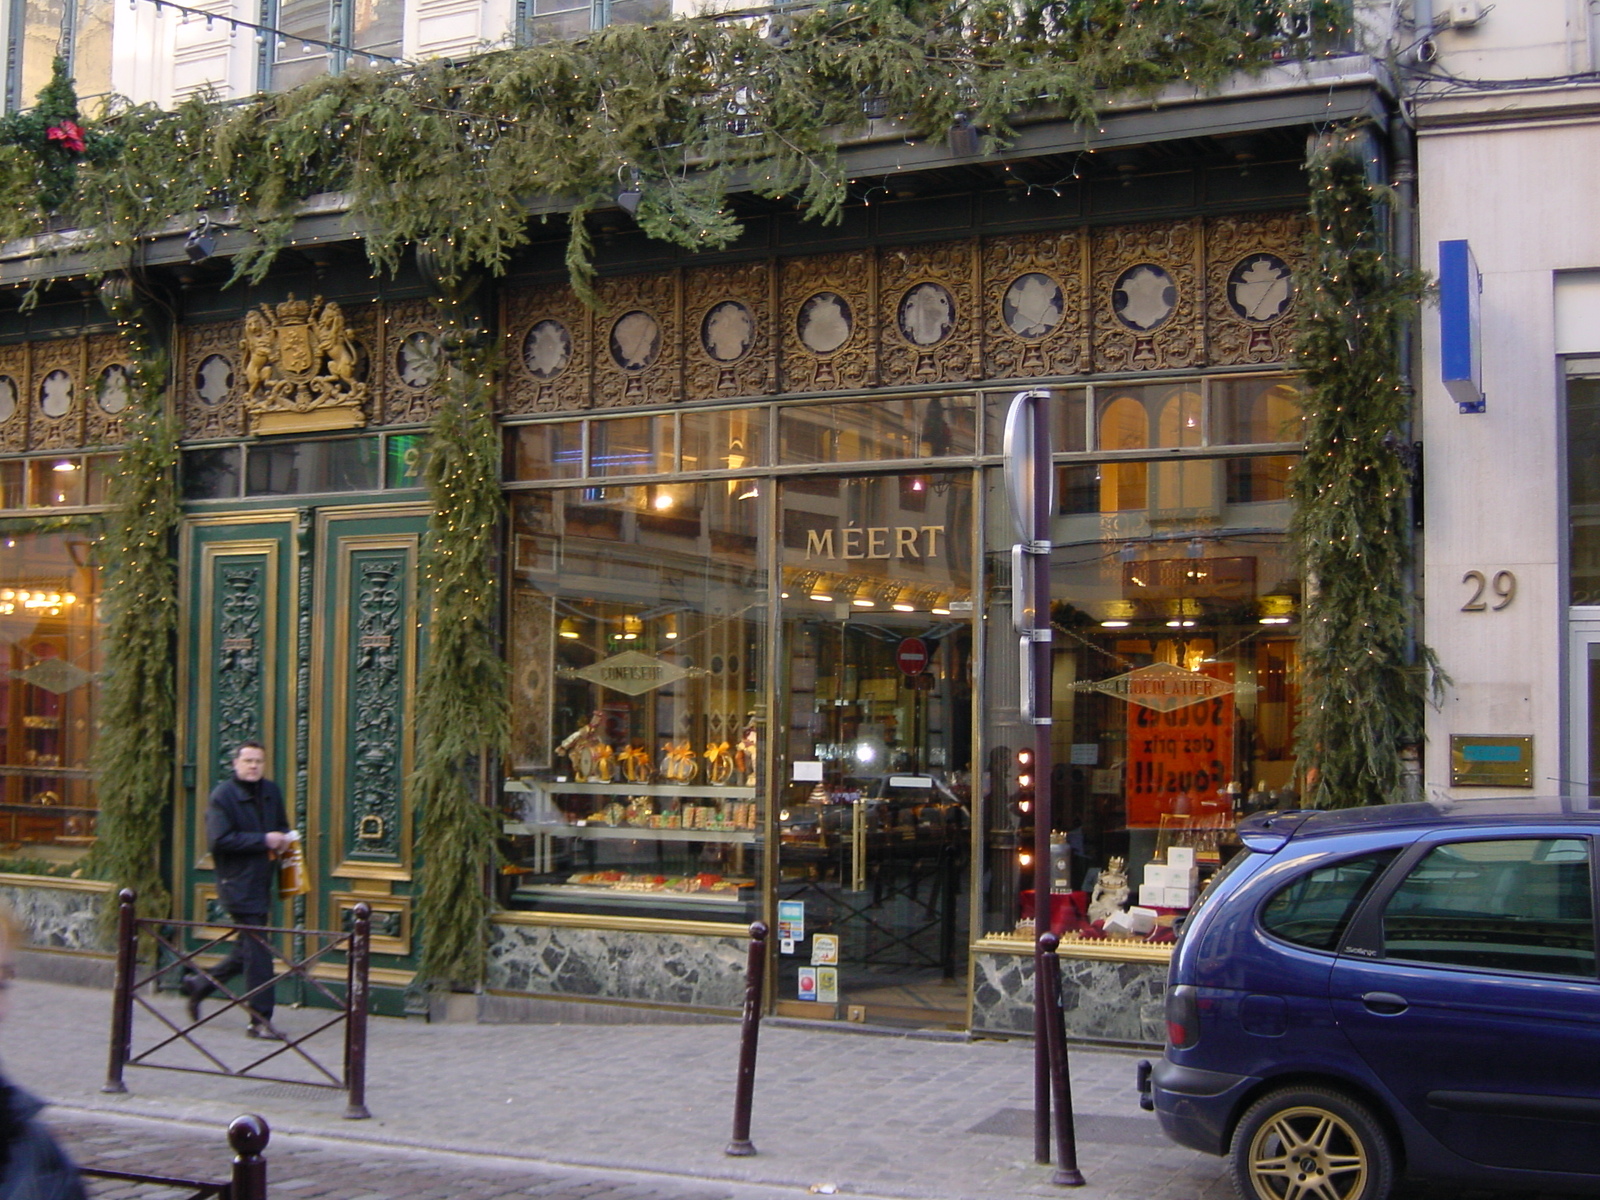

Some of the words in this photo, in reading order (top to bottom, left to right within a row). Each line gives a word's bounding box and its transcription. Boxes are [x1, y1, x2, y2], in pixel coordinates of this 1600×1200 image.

[805, 520, 945, 561] MÉERT
[1460, 569, 1518, 612] 29
[600, 665, 664, 682] CONFISEUR
[1115, 678, 1212, 695] CHOCOLATIER
